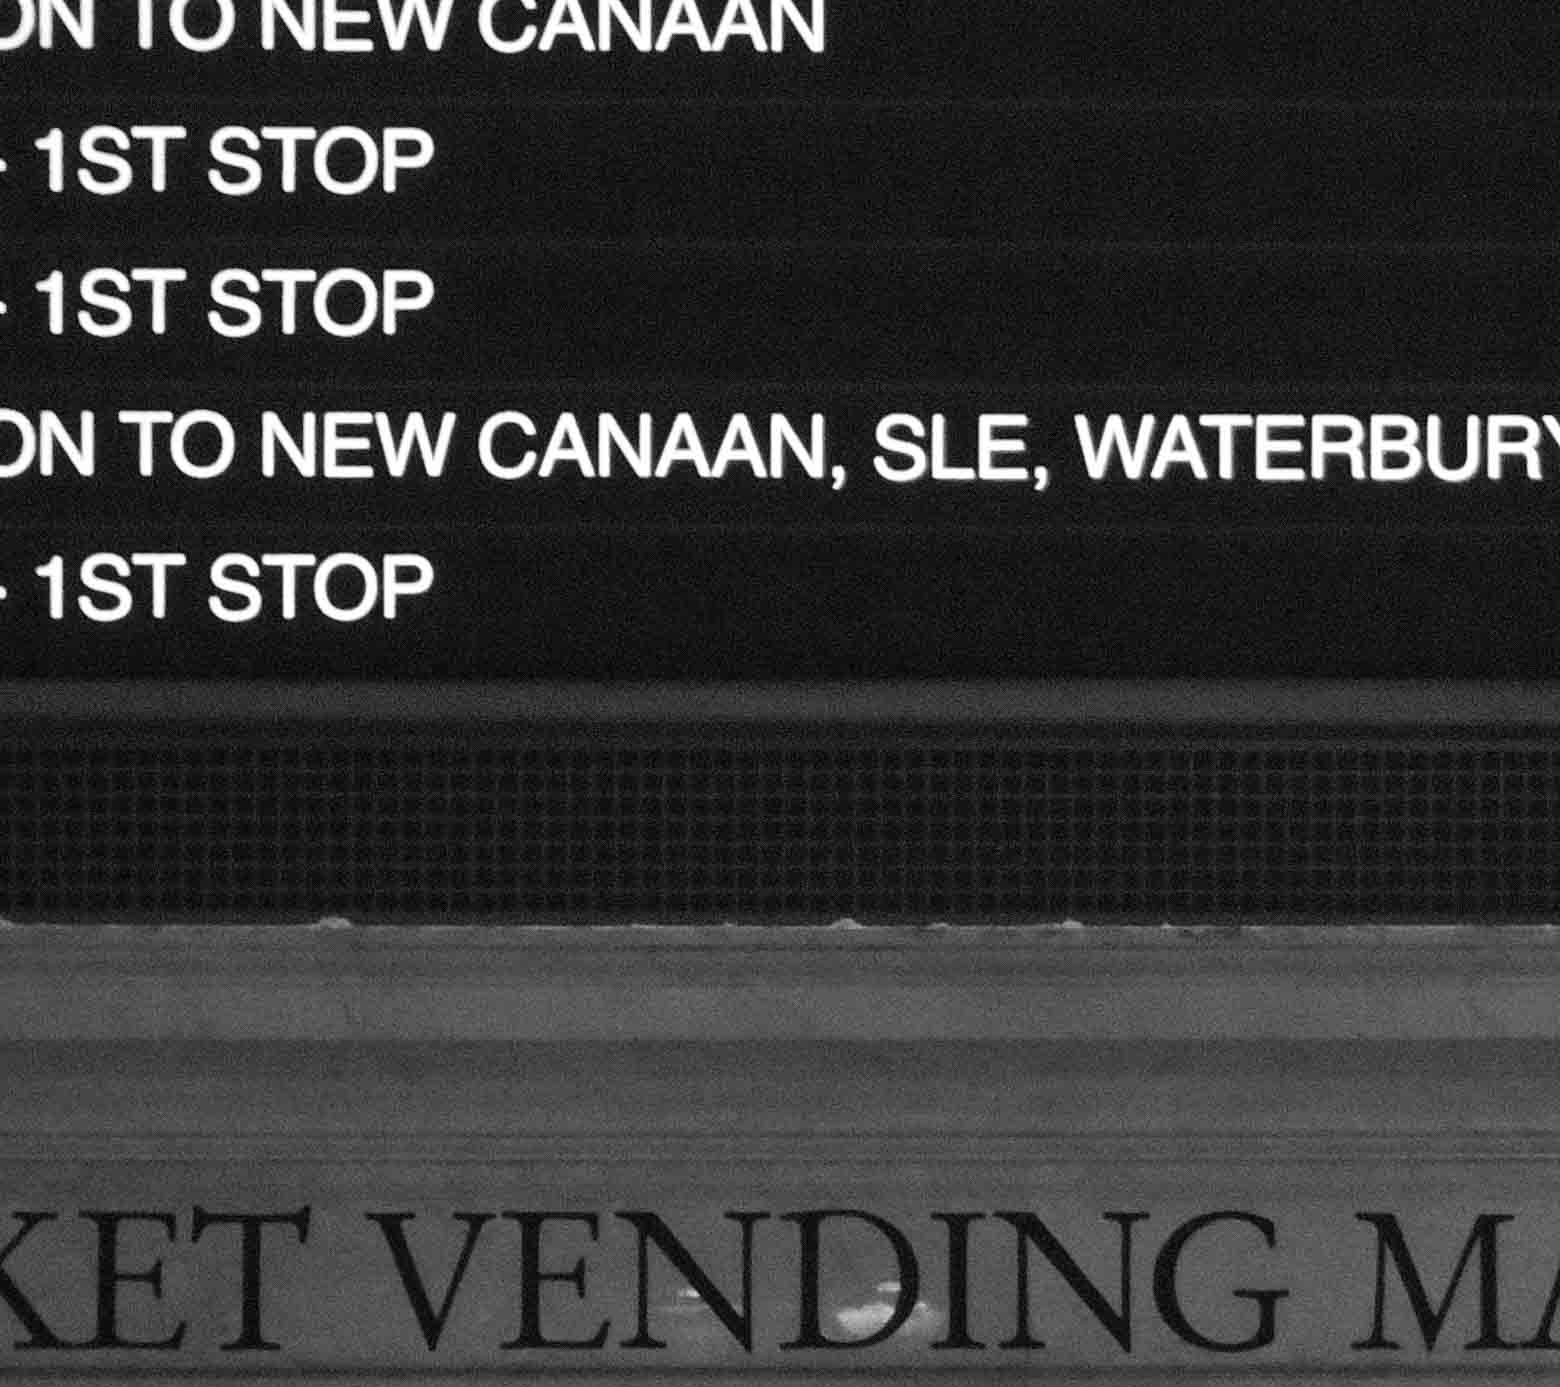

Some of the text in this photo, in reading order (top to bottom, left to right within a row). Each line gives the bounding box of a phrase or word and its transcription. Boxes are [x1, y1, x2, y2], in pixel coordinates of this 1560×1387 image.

[259, 0, 456, 54] NEW
[476, 0, 826, 55] CANAAN
[33, 123, 436, 198] 1ST STOP
[34, 266, 436, 339] 1ST STOP
[116, 407, 237, 481] TO
[260, 409, 458, 480] NEW
[476, 409, 848, 492] CANAAN,
[871, 411, 1050, 493] SLE,
[34, 551, 436, 624] 1ST STOP
[366, 1210, 1292, 1354] VENDING
